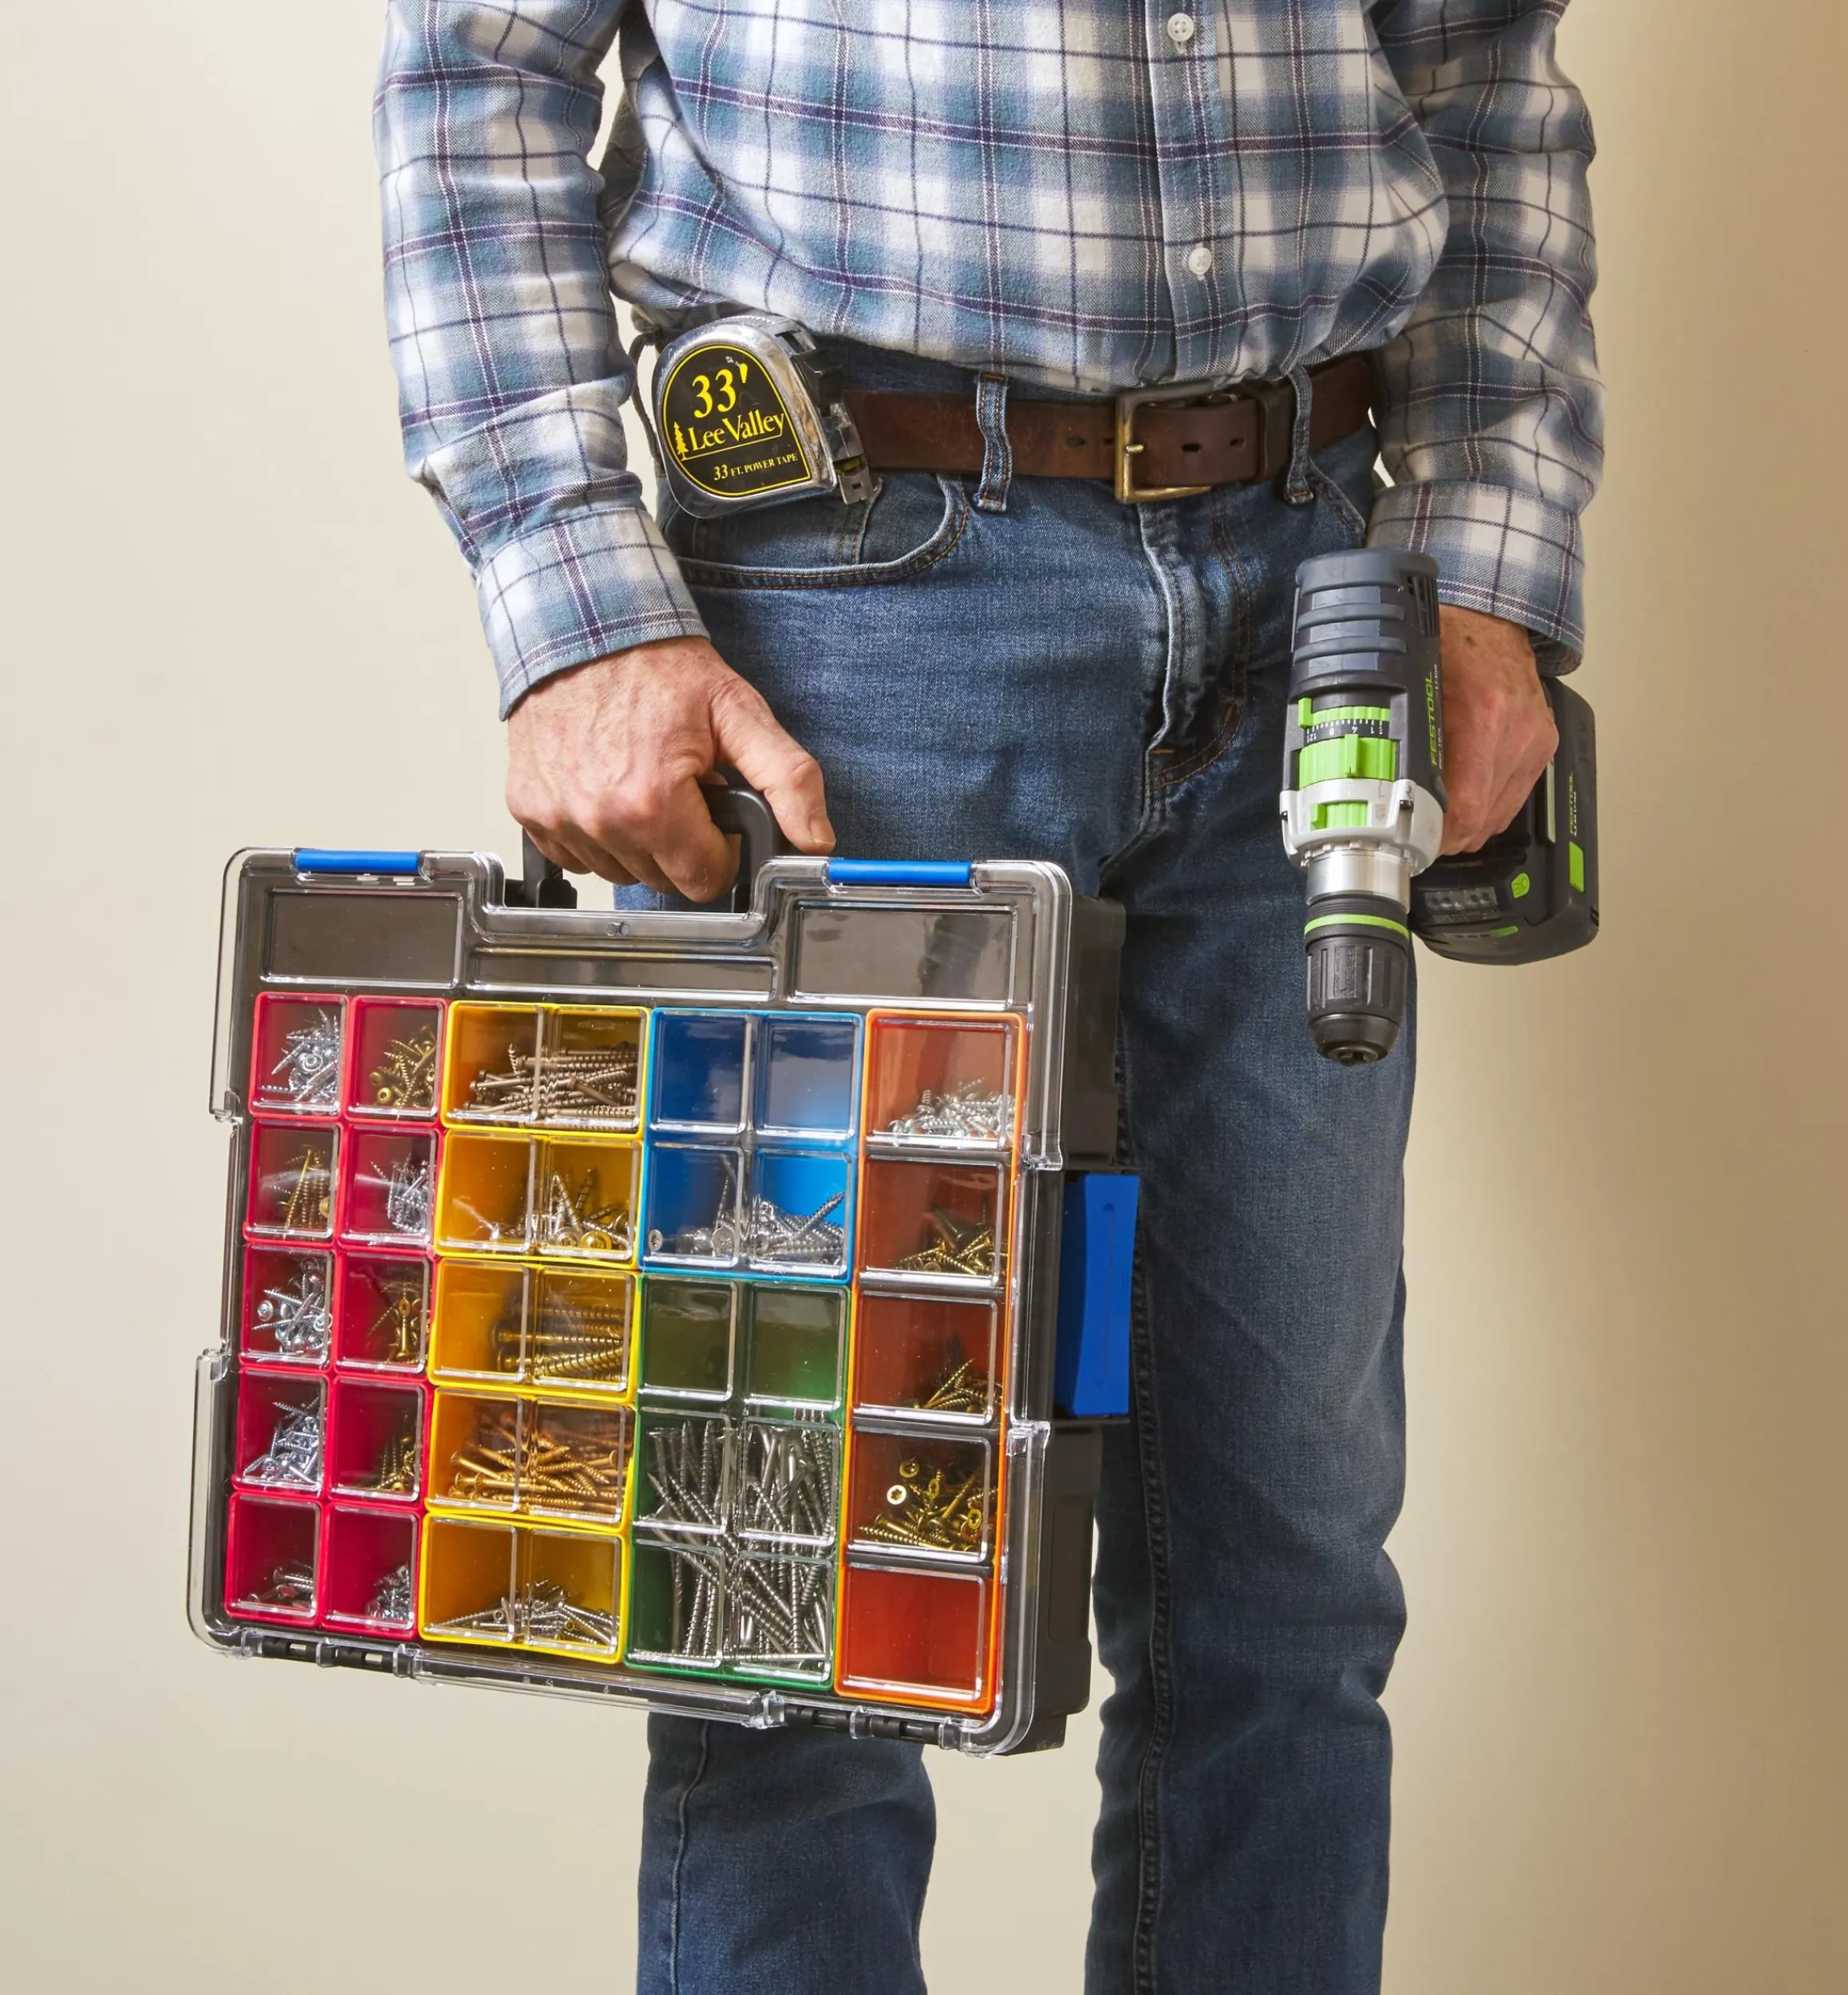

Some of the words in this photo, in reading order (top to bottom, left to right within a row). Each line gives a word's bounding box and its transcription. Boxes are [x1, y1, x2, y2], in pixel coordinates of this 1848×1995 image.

[692, 363, 748, 418] 33'
[688, 427, 726, 451] Lee
[721, 409, 784, 442] Valley
[713, 464, 729, 480] 33
[730, 466, 744, 476] FT.
[744, 458, 775, 473] POWER
[776, 452, 799, 465] TAPE
[1425, 671, 1437, 766] FESTOOL
